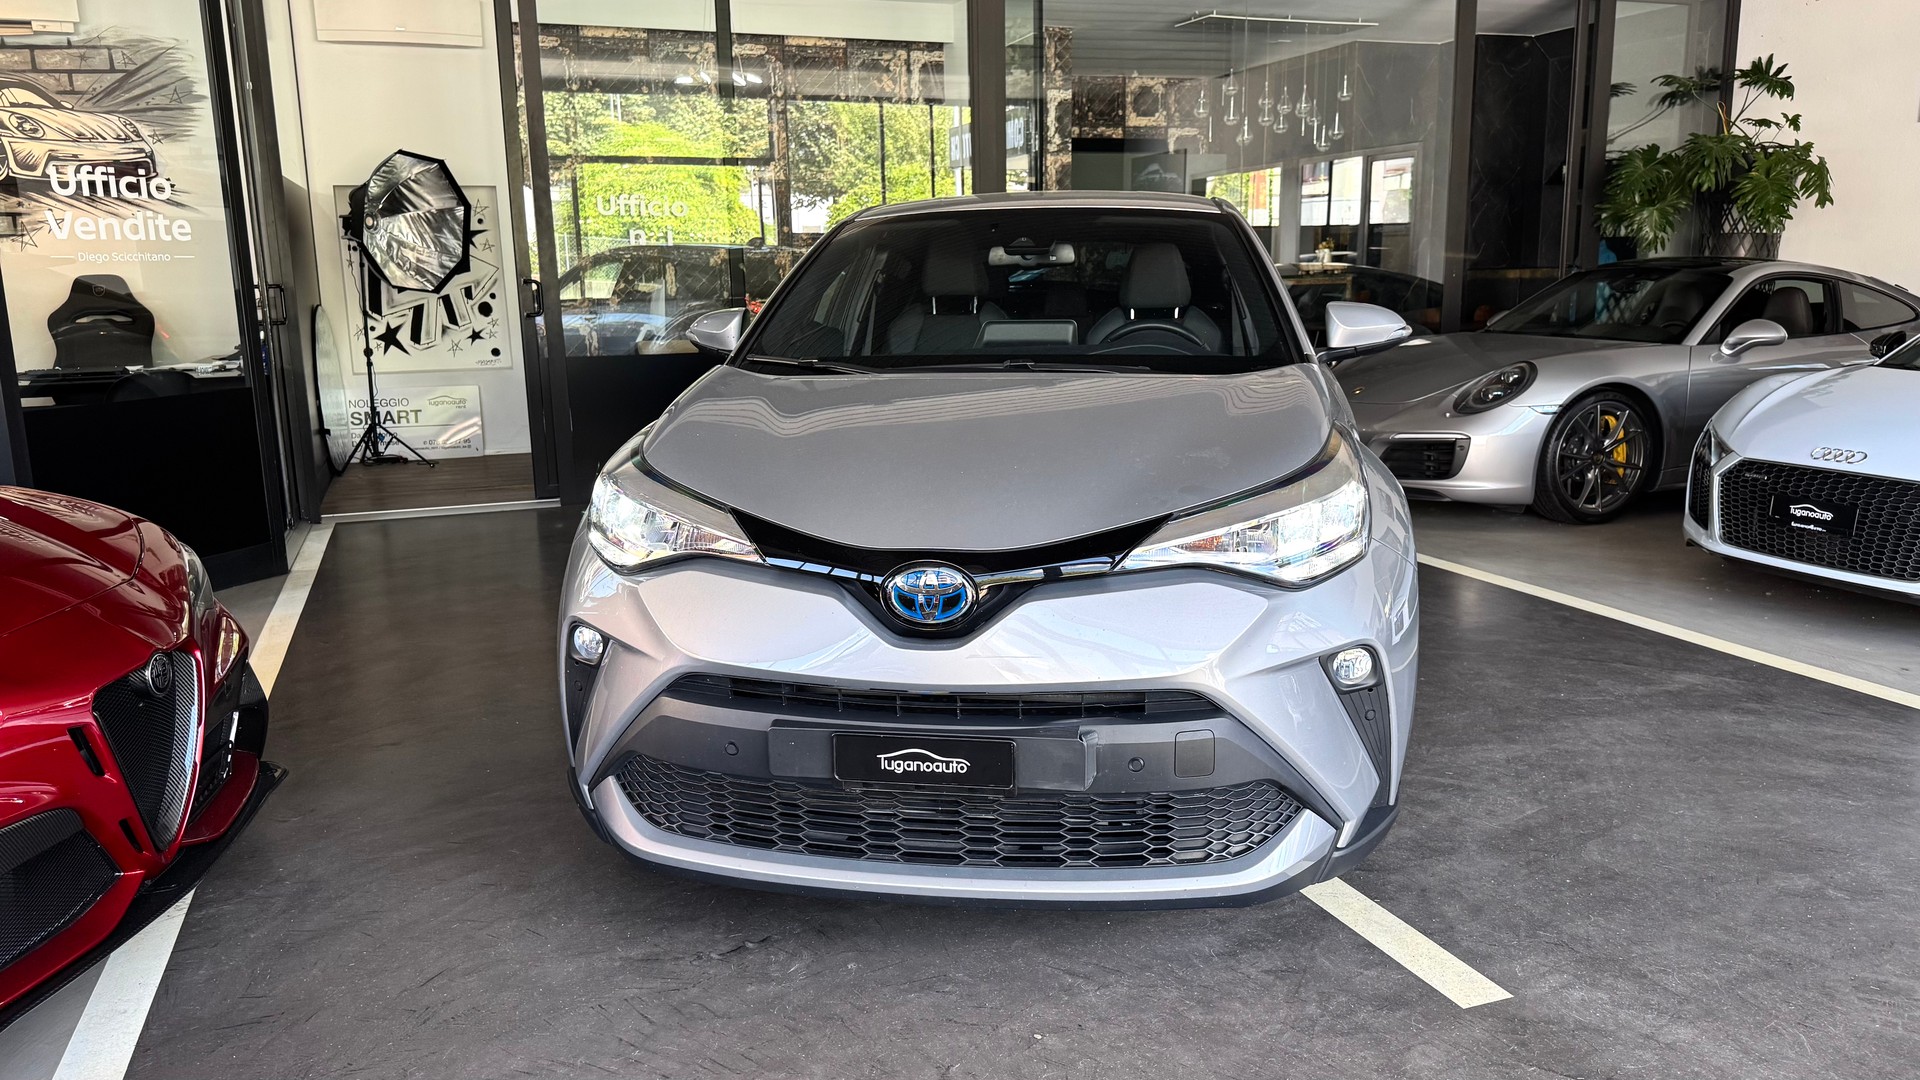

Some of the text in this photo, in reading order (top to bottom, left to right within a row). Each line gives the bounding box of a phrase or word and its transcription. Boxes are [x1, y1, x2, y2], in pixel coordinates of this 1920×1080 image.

[49, 164, 172, 200] Ufficio
[596, 193, 688, 217] Ufficio
[44, 210, 192, 241] Vendite
[77, 251, 171, 263] Diego Scicchitano
[348, 397, 410, 408] NOLEGGIO
[350, 409, 422, 426] SMART
